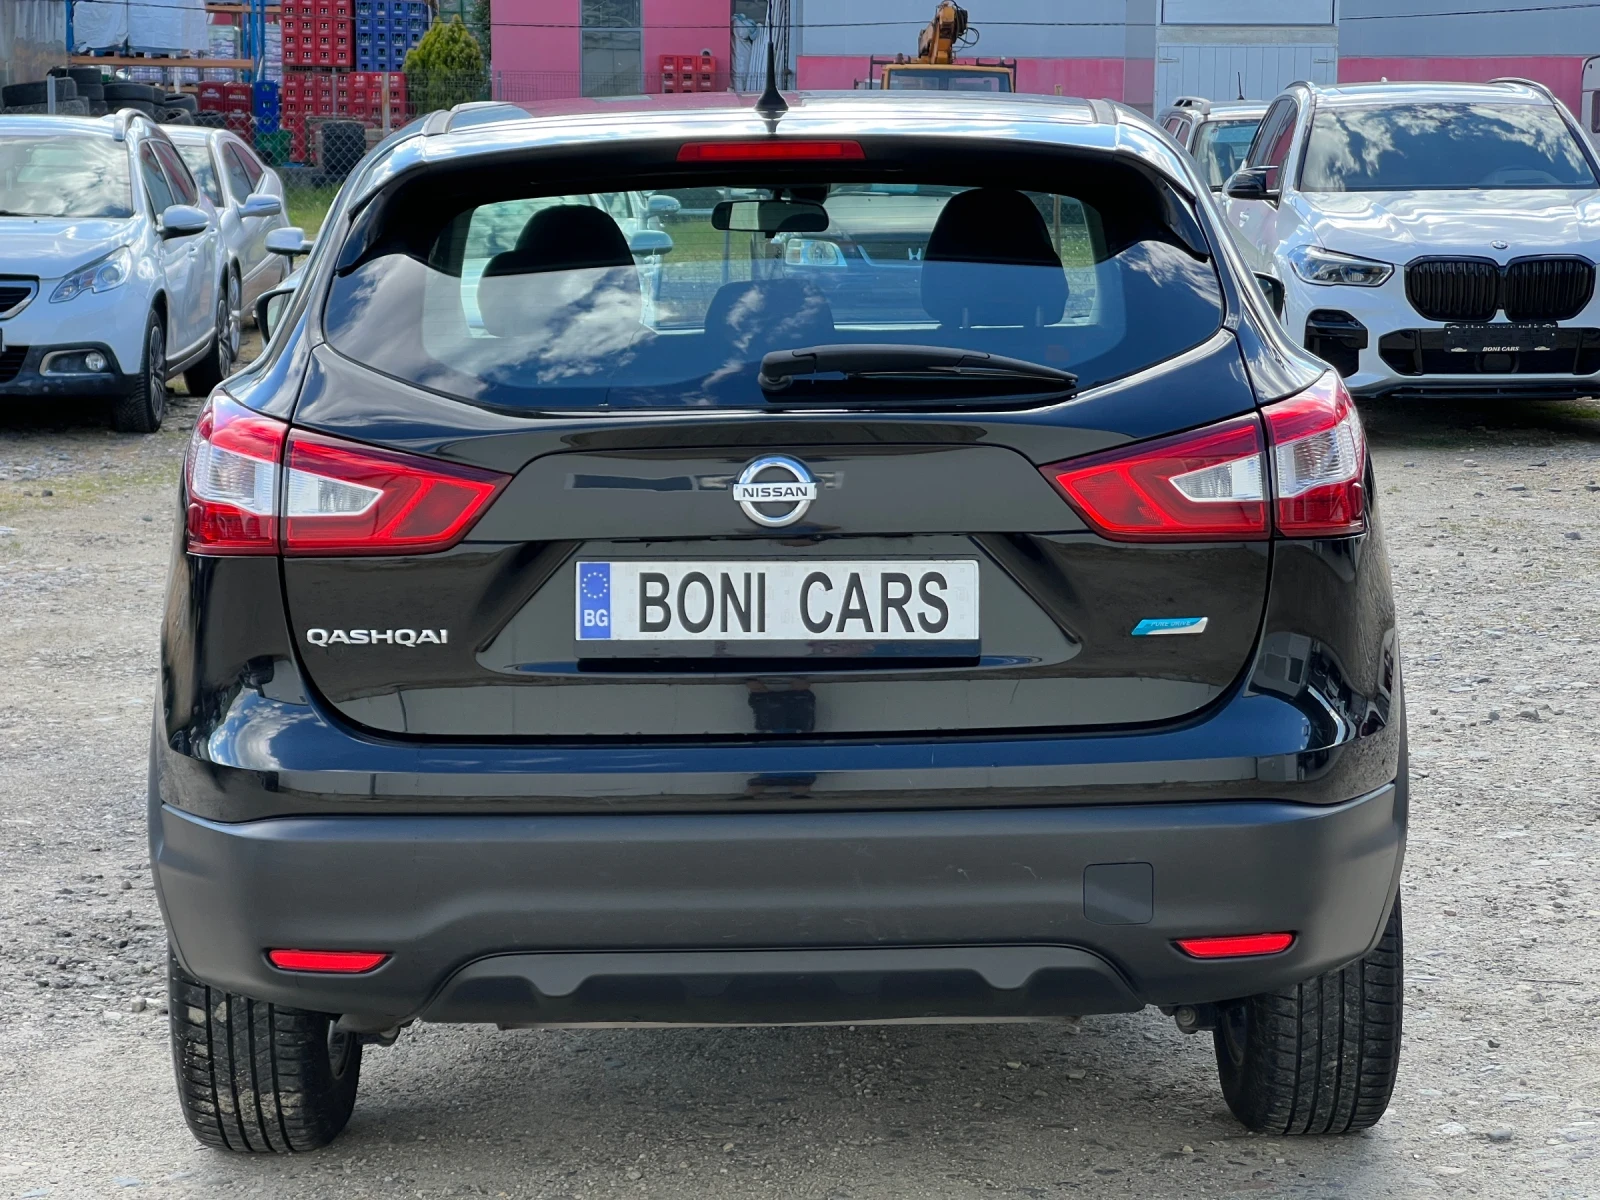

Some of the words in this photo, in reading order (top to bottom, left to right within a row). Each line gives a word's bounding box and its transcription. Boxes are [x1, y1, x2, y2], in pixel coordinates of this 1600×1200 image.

[742, 486, 808, 498] NISSAN
[638, 571, 766, 634] BONI
[799, 570, 950, 635] CARS
[583, 608, 609, 627] BG
[306, 628, 448, 648] QASHQAI
